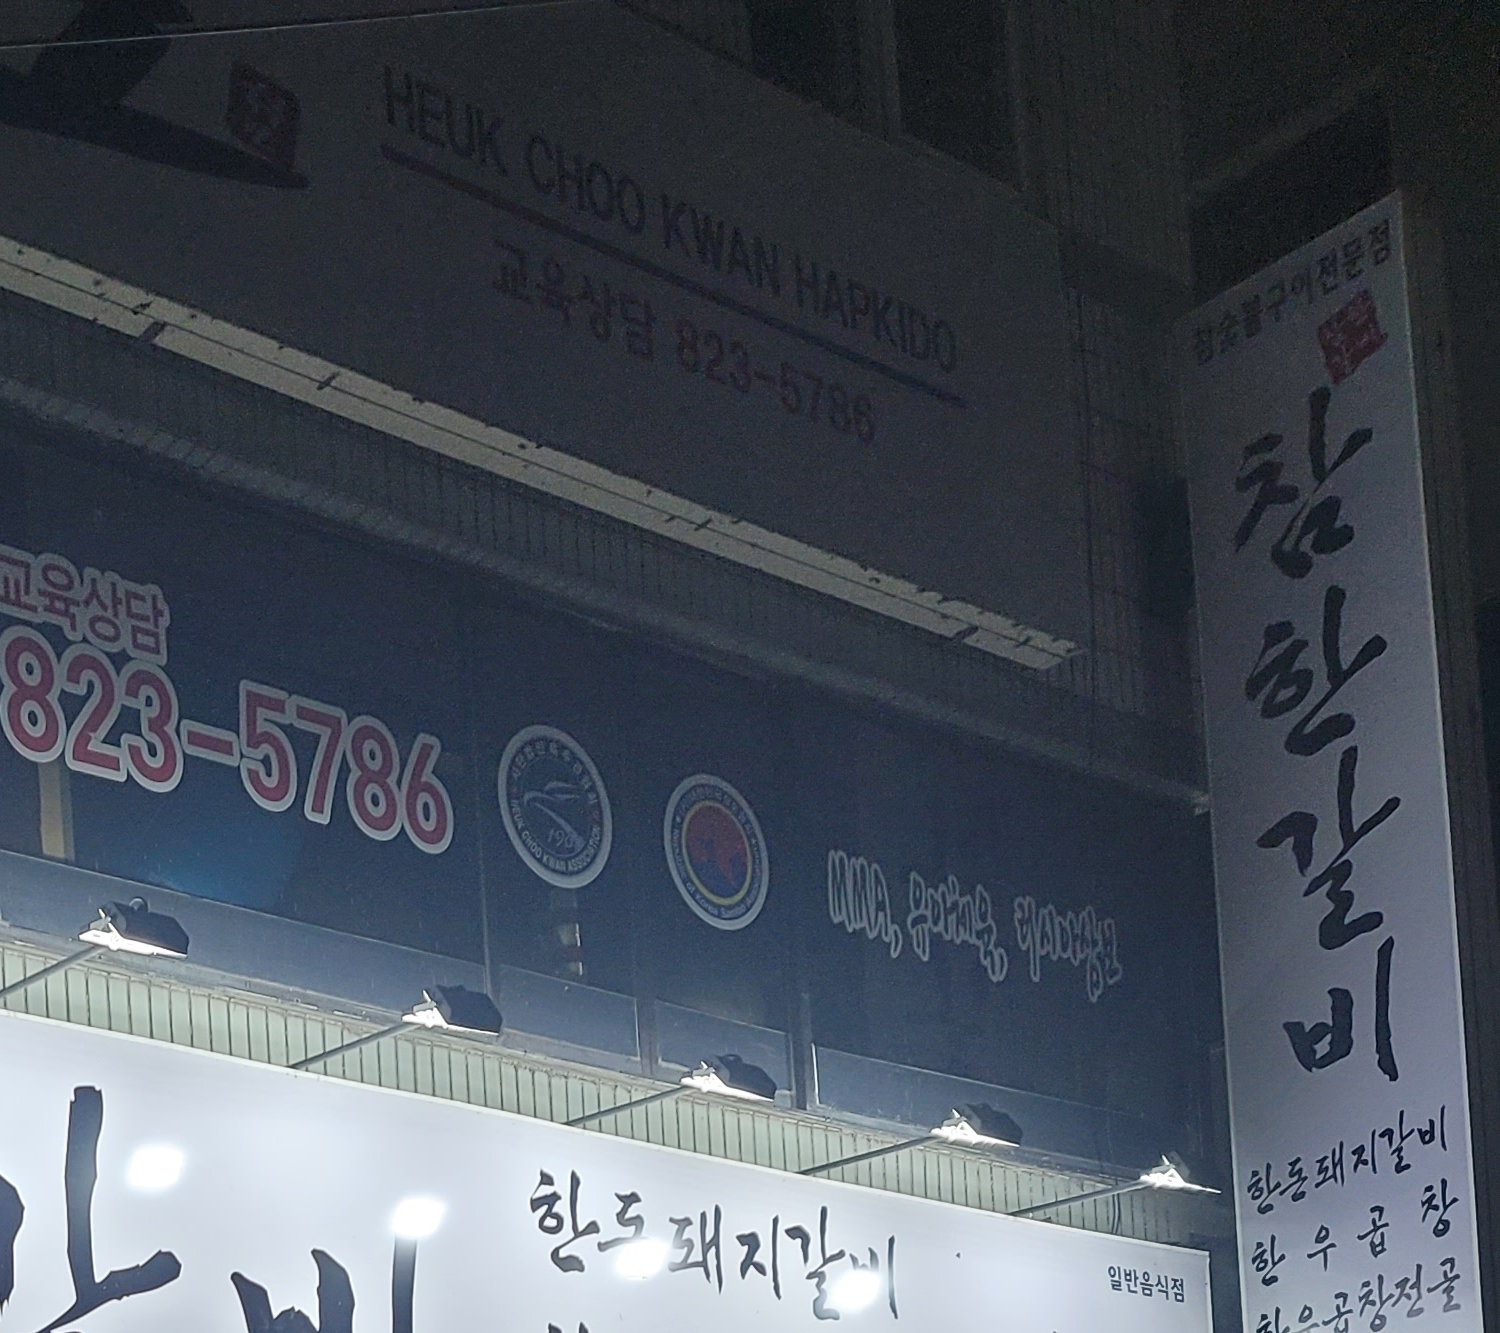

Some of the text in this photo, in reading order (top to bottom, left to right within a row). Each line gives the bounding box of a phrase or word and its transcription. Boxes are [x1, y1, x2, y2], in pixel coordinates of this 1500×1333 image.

[384, 66, 508, 176] HEUK
[525, 135, 645, 234] CHOO
[662, 194, 780, 296] KWAN
[794, 254, 958, 372] HAPKIDO
[491, 239, 875, 444] 교육상담 823-5786
[1235, 385, 1400, 1081] 참한갈비
[1247, 1105, 1447, 1214] 한돈돼지갈비
[1107, 1265, 1185, 1303] 일반음식점
